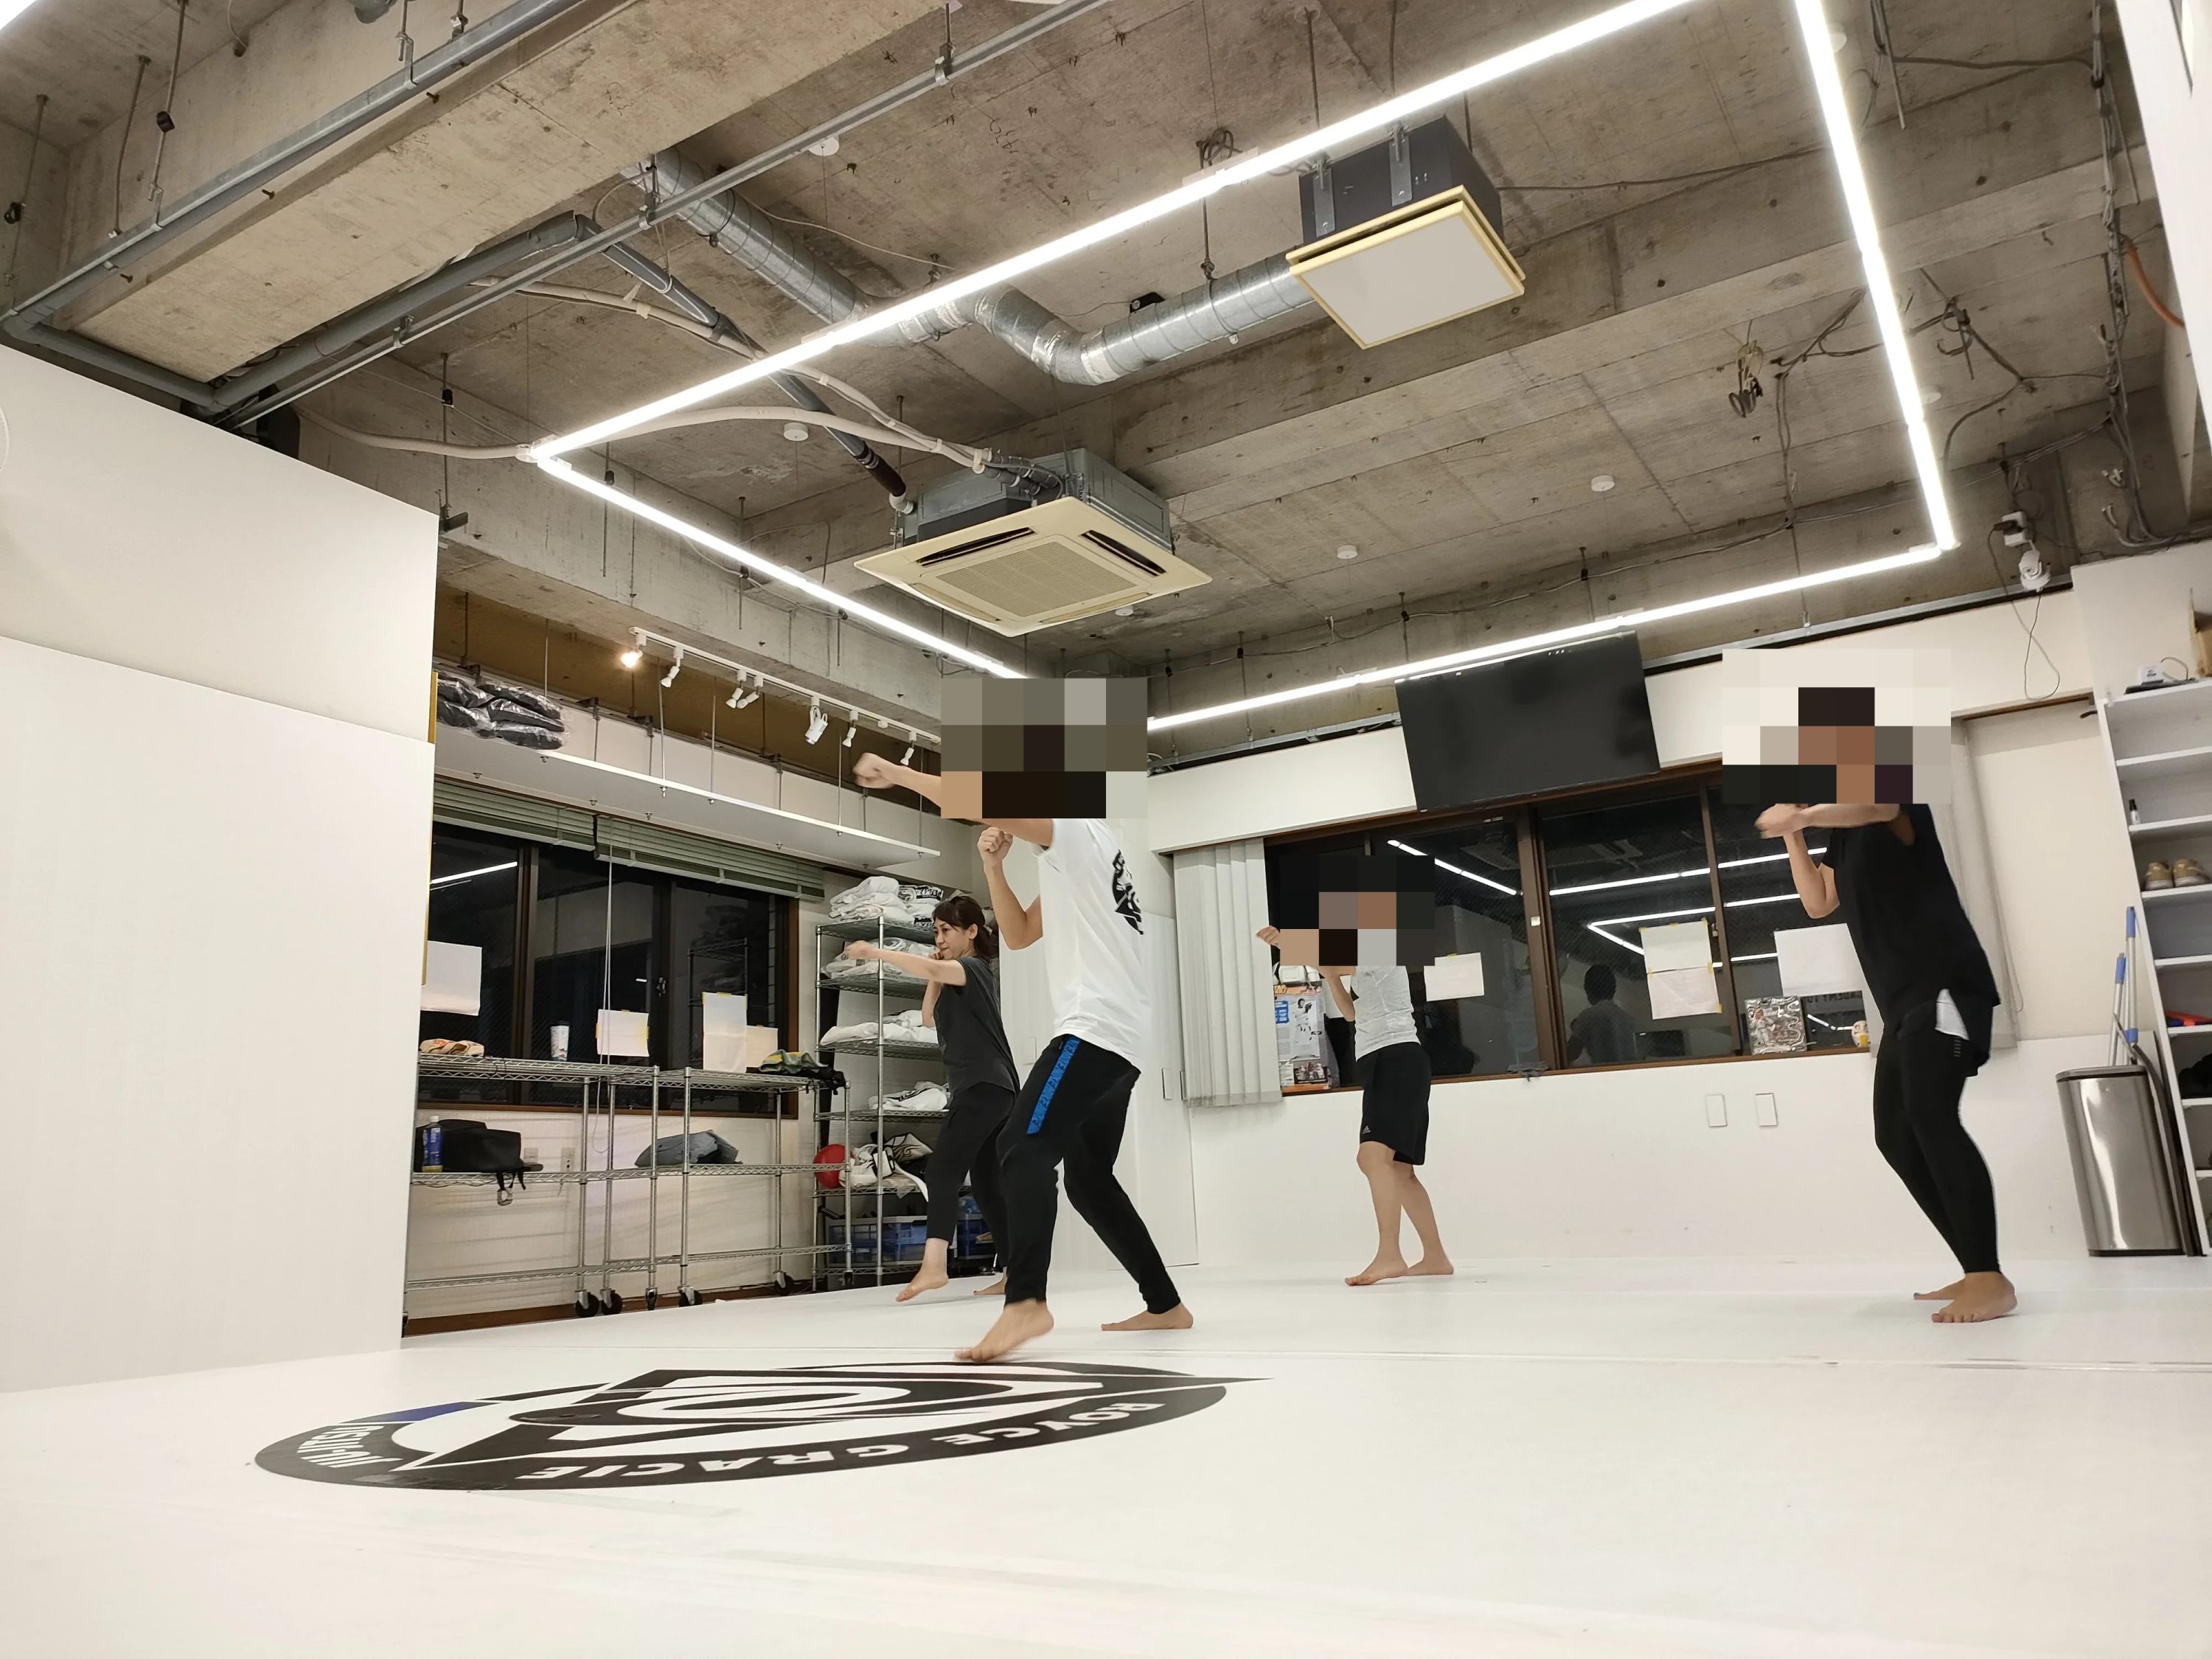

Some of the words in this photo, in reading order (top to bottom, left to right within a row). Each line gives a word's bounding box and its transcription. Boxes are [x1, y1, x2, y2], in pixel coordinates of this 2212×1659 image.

[931, 1402, 1166, 1446] ROYCE
[296, 1425, 404, 1469] JIU-JITSU
[515, 1444, 909, 1480] GRACIE
